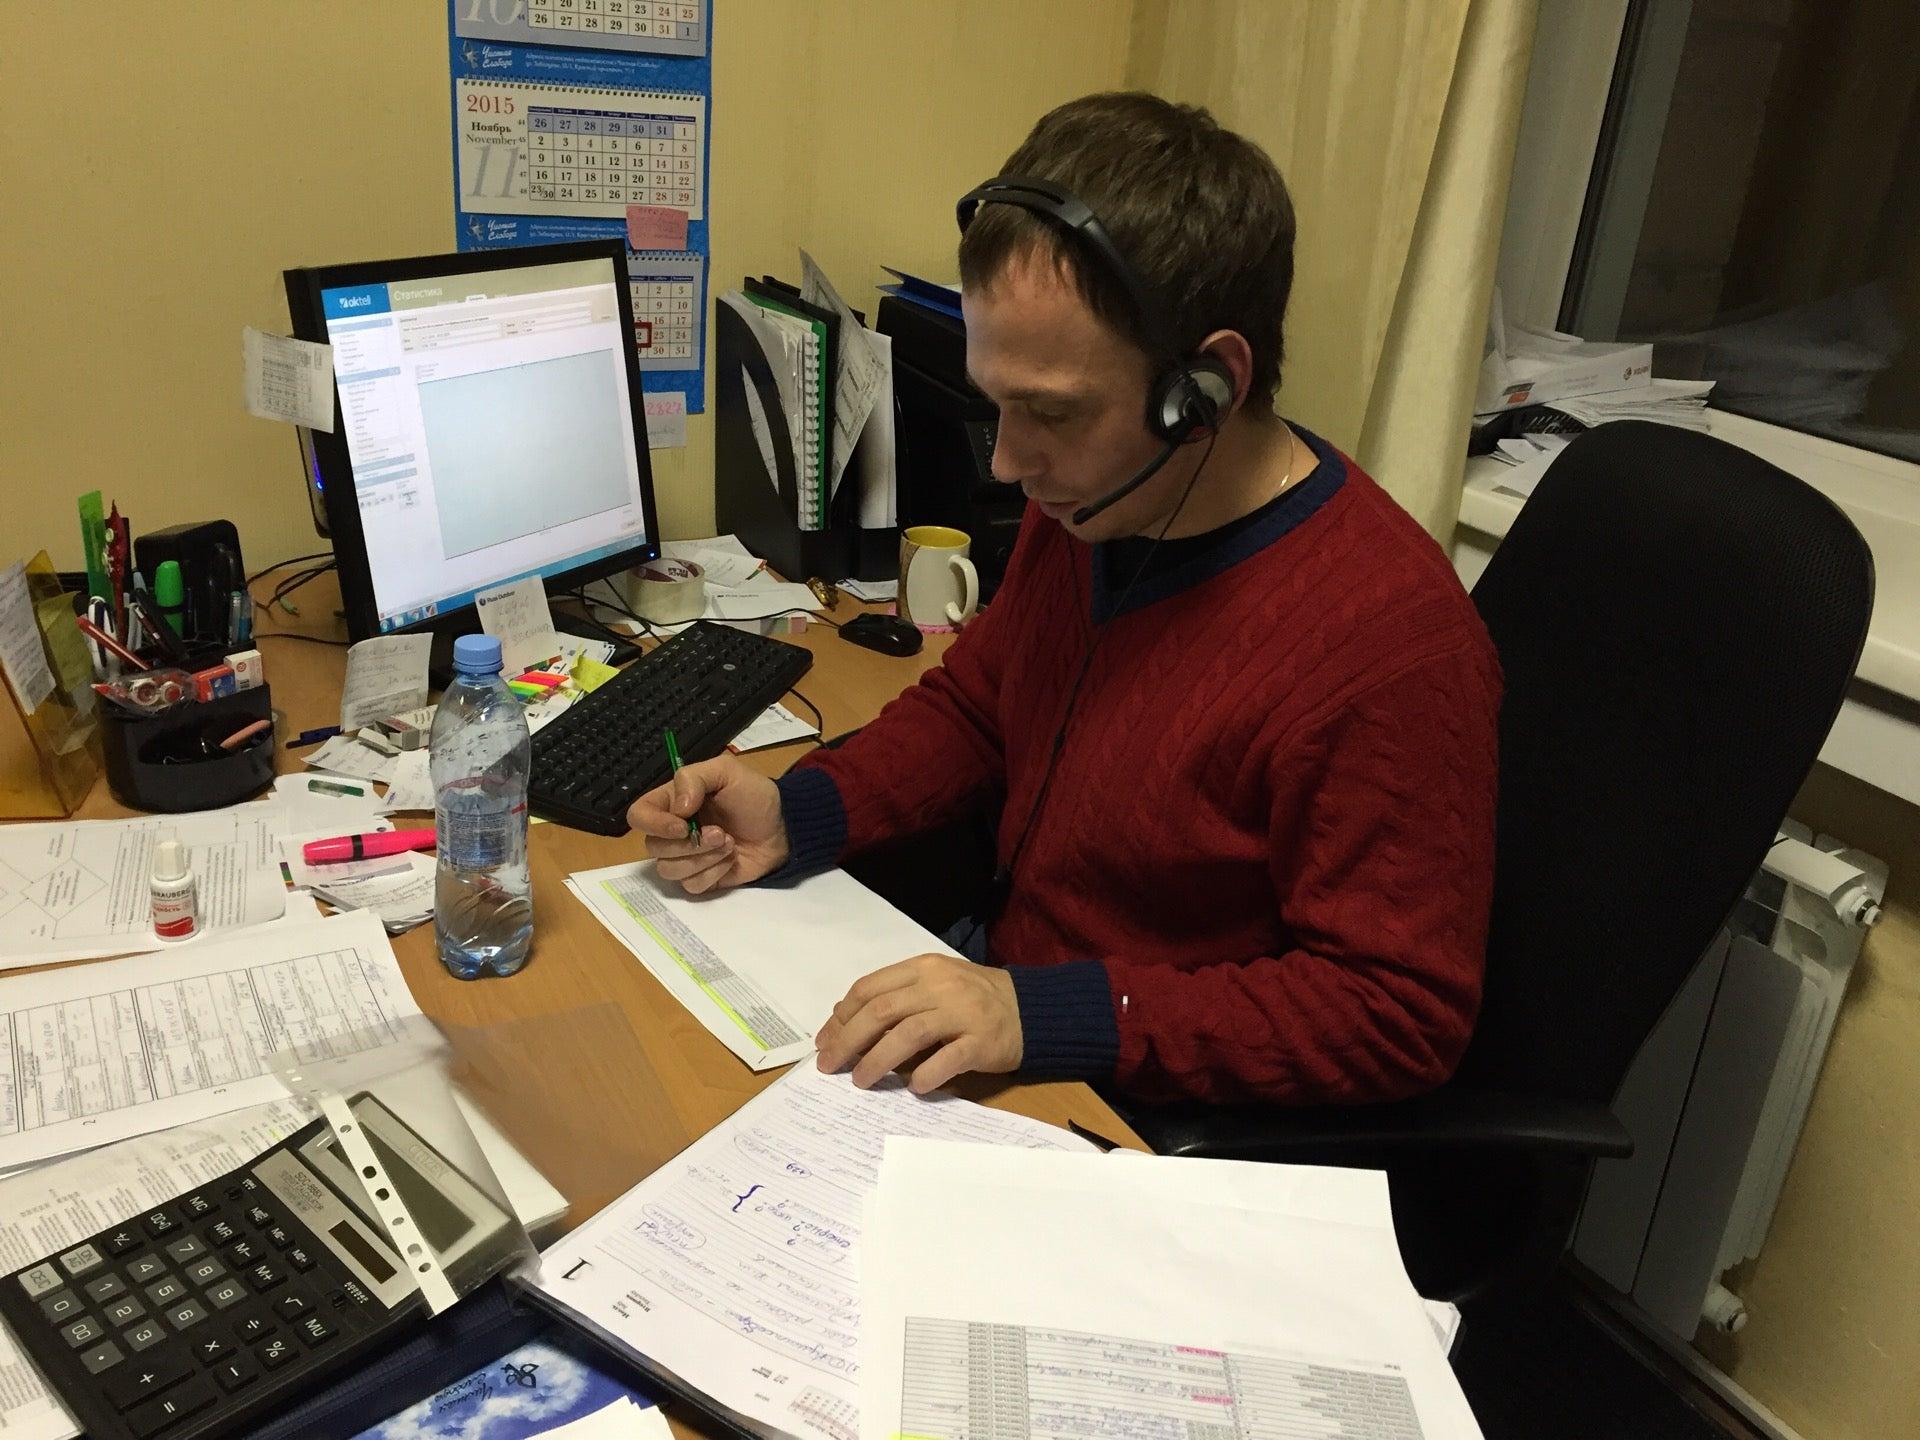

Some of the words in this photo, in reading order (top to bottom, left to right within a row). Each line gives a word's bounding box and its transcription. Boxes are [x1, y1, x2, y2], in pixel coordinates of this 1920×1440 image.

[533, 0, 547, 9] 19
[560, 0, 574, 10] 20
[585, 0, 598, 11] 21
[610, 2, 623, 13] 22
[634, 4, 647, 16] 23
[658, 6, 671, 17] 24
[682, 8, 694, 19] 25
[534, 13, 548, 25] 26
[560, 16, 574, 27] 27
[585, 17, 598, 29] 28
[610, 20, 623, 31] 29
[634, 22, 647, 33] 30
[658, 24, 671, 36] 31
[685, 26, 691, 37] 1
[466, 94, 515, 115] 2015
[471, 121, 512, 135] Ноябрь
[534, 118, 548, 129] 26
[559, 120, 572, 131] 27
[583, 121, 597, 132] 28
[608, 122, 621, 133] 29
[632, 124, 645, 135] 30
[656, 126, 668, 136] 31
[681, 127, 687, 138] 1
[466, 133, 517, 146] November
[538, 135, 544, 147] 2
[562, 137, 569, 148] 3
[586, 138, 594, 149] 4
[611, 140, 618, 151] 5
[634, 140, 642, 151] 6
[658, 142, 665, 153] 7
[681, 143, 688, 154] 8
[538, 153, 546, 163] 9
[560, 154, 572, 165] 10
[584, 155, 596, 166] 11
[608, 156, 621, 167] 12
[632, 157, 644, 169] 13
[655, 159, 667, 170] 14
[678, 160, 690, 171] 15
[465, 145, 520, 199] 11
[536, 170, 549, 181] 16
[560, 171, 573, 182] 17
[584, 171, 597, 183] 18
[608, 173, 621, 184] 19
[632, 174, 645, 185] 20
[655, 175, 667, 186] 21
[678, 175, 690, 186] 22
[560, 187, 574, 198] 24
[584, 189, 598, 200] 25
[608, 189, 621, 200] 26
[632, 190, 644, 201] 27
[655, 191, 668, 202] 28
[678, 192, 690, 203] 29
[393, 287, 443, 301] Статистика
[635, 286, 639, 295] 1
[656, 286, 662, 295] 2
[678, 286, 684, 295] 3
[634, 301, 640, 310] 8
[656, 301, 663, 310] 9
[677, 301, 688, 310] 10
[654, 316, 665, 325] 16
[676, 316, 686, 325] 17
[653, 331, 665, 340] 23
[676, 331, 686, 340] 24
[653, 346, 665, 355] 30
[675, 345, 686, 355] 31
[150, 888, 191, 899] BRAUBERG
[188, 1195, 209, 1213] MC
[213, 1221, 234, 1239] MR
[178, 1243, 195, 1254] 7
[139, 1262, 154, 1274] 4
[198, 1265, 214, 1278] 8
[560, 1256, 594, 1282] 1
[28, 1269, 51, 1290] DEC
[98, 1282, 113, 1294] 1
[158, 1284, 175, 1298] 5
[218, 1287, 235, 1301] 9
[115, 1305, 133, 1318] 2
[178, 1309, 195, 1322] 6
[304, 1318, 328, 1338] MU
[136, 1329, 153, 1343] 3
